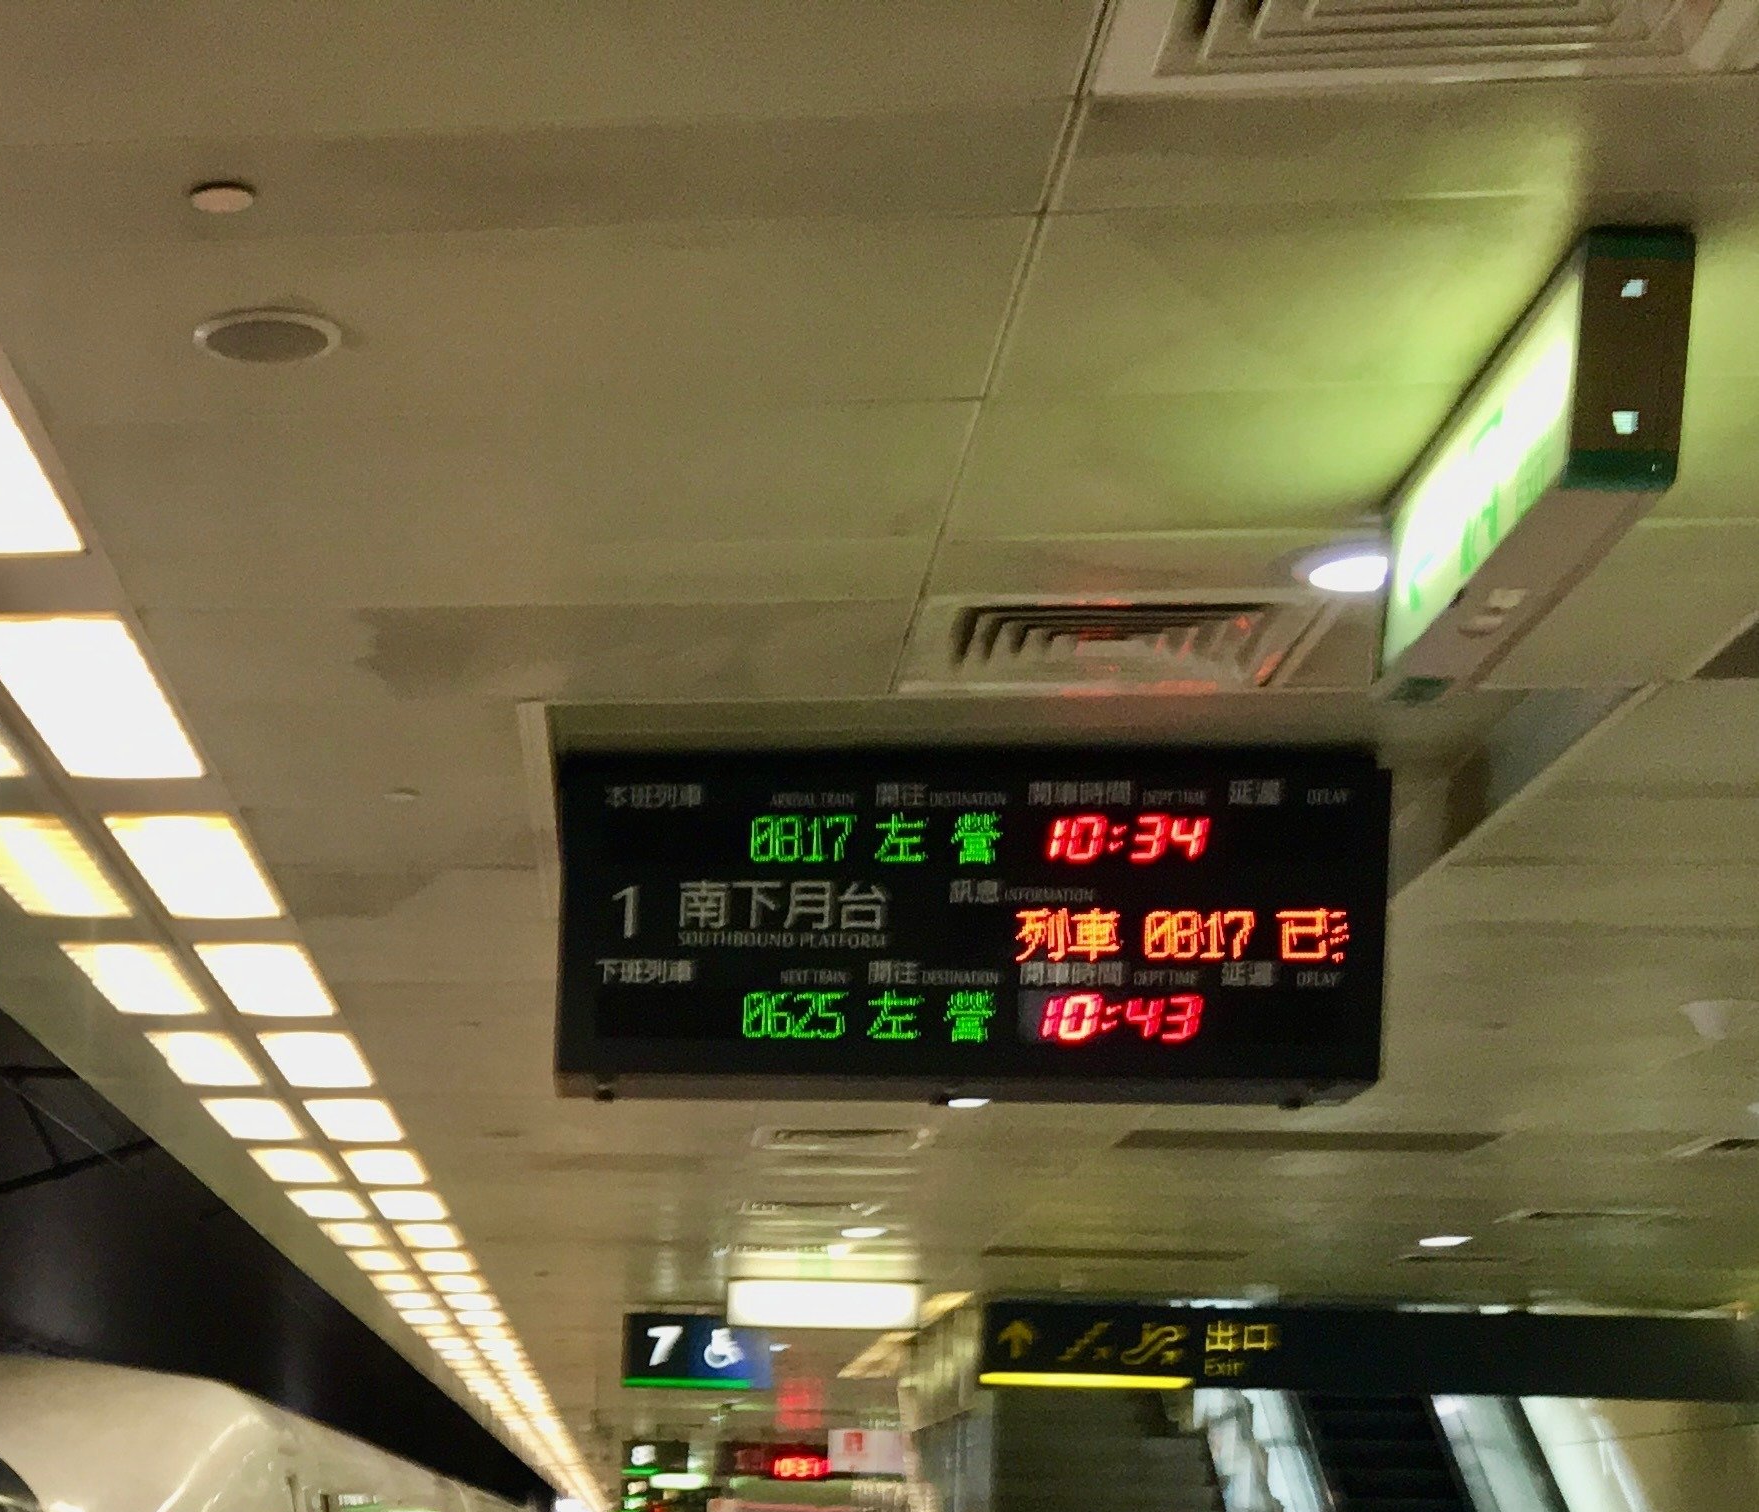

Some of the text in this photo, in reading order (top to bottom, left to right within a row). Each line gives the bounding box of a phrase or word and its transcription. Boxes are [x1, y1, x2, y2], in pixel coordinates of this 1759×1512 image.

[820, 791, 856, 808] TRAIN
[875, 782, 928, 808] 開往
[930, 791, 1007, 808] DESTINATION
[1307, 788, 1350, 805] DELAY
[750, 813, 858, 864] 0817
[1046, 814, 1212, 863] 10:34
[611, 879, 890, 940] 1 南下月台
[1004, 888, 1095, 904] INFORMATION
[678, 932, 889, 950] SOUTHBOUND PLATFORM
[1014, 907, 1122, 962] 列車
[1143, 909, 1255, 960] 0817
[596, 957, 697, 985] 下班列車
[780, 969, 813, 985] NEXT
[814, 969, 848, 985] TRAIN
[868, 959, 922, 985] 開往
[922, 969, 1000, 986] DESTINATION
[1020, 960, 1125, 987] 開車時間
[1168, 970, 1200, 987] TIME
[1297, 970, 1340, 987] DELAY
[743, 989, 849, 1041] 0625
[1038, 993, 1205, 1043] 10:43
[646, 1325, 684, 1367] 7
[1204, 1319, 1274, 1352] 出口
[1204, 1356, 1243, 1377] Exit
